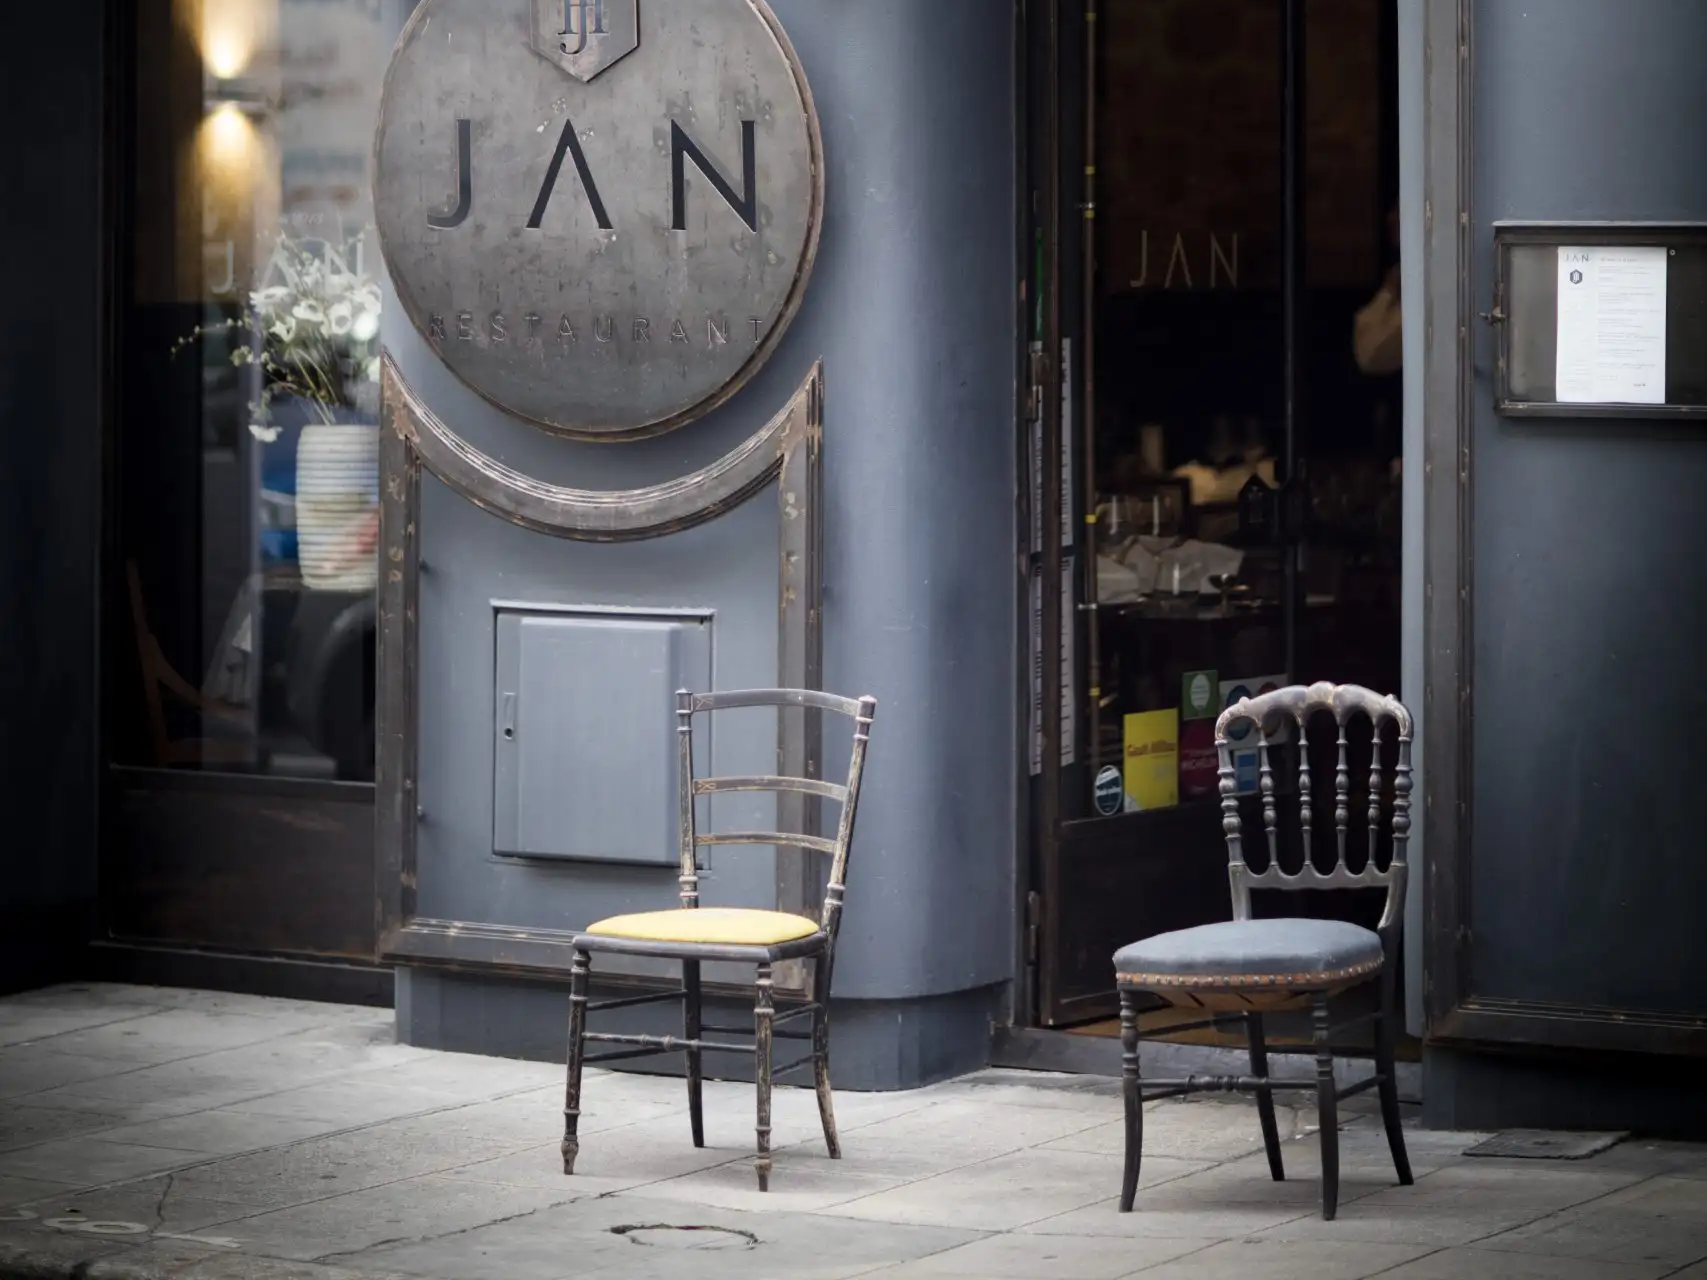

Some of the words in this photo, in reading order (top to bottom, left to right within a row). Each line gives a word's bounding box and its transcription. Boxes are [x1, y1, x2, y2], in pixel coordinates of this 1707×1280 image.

[426, 117, 758, 234] JAN
[1130, 229, 1238, 289] JAN
[428, 310, 764, 346] RESTAURANT
